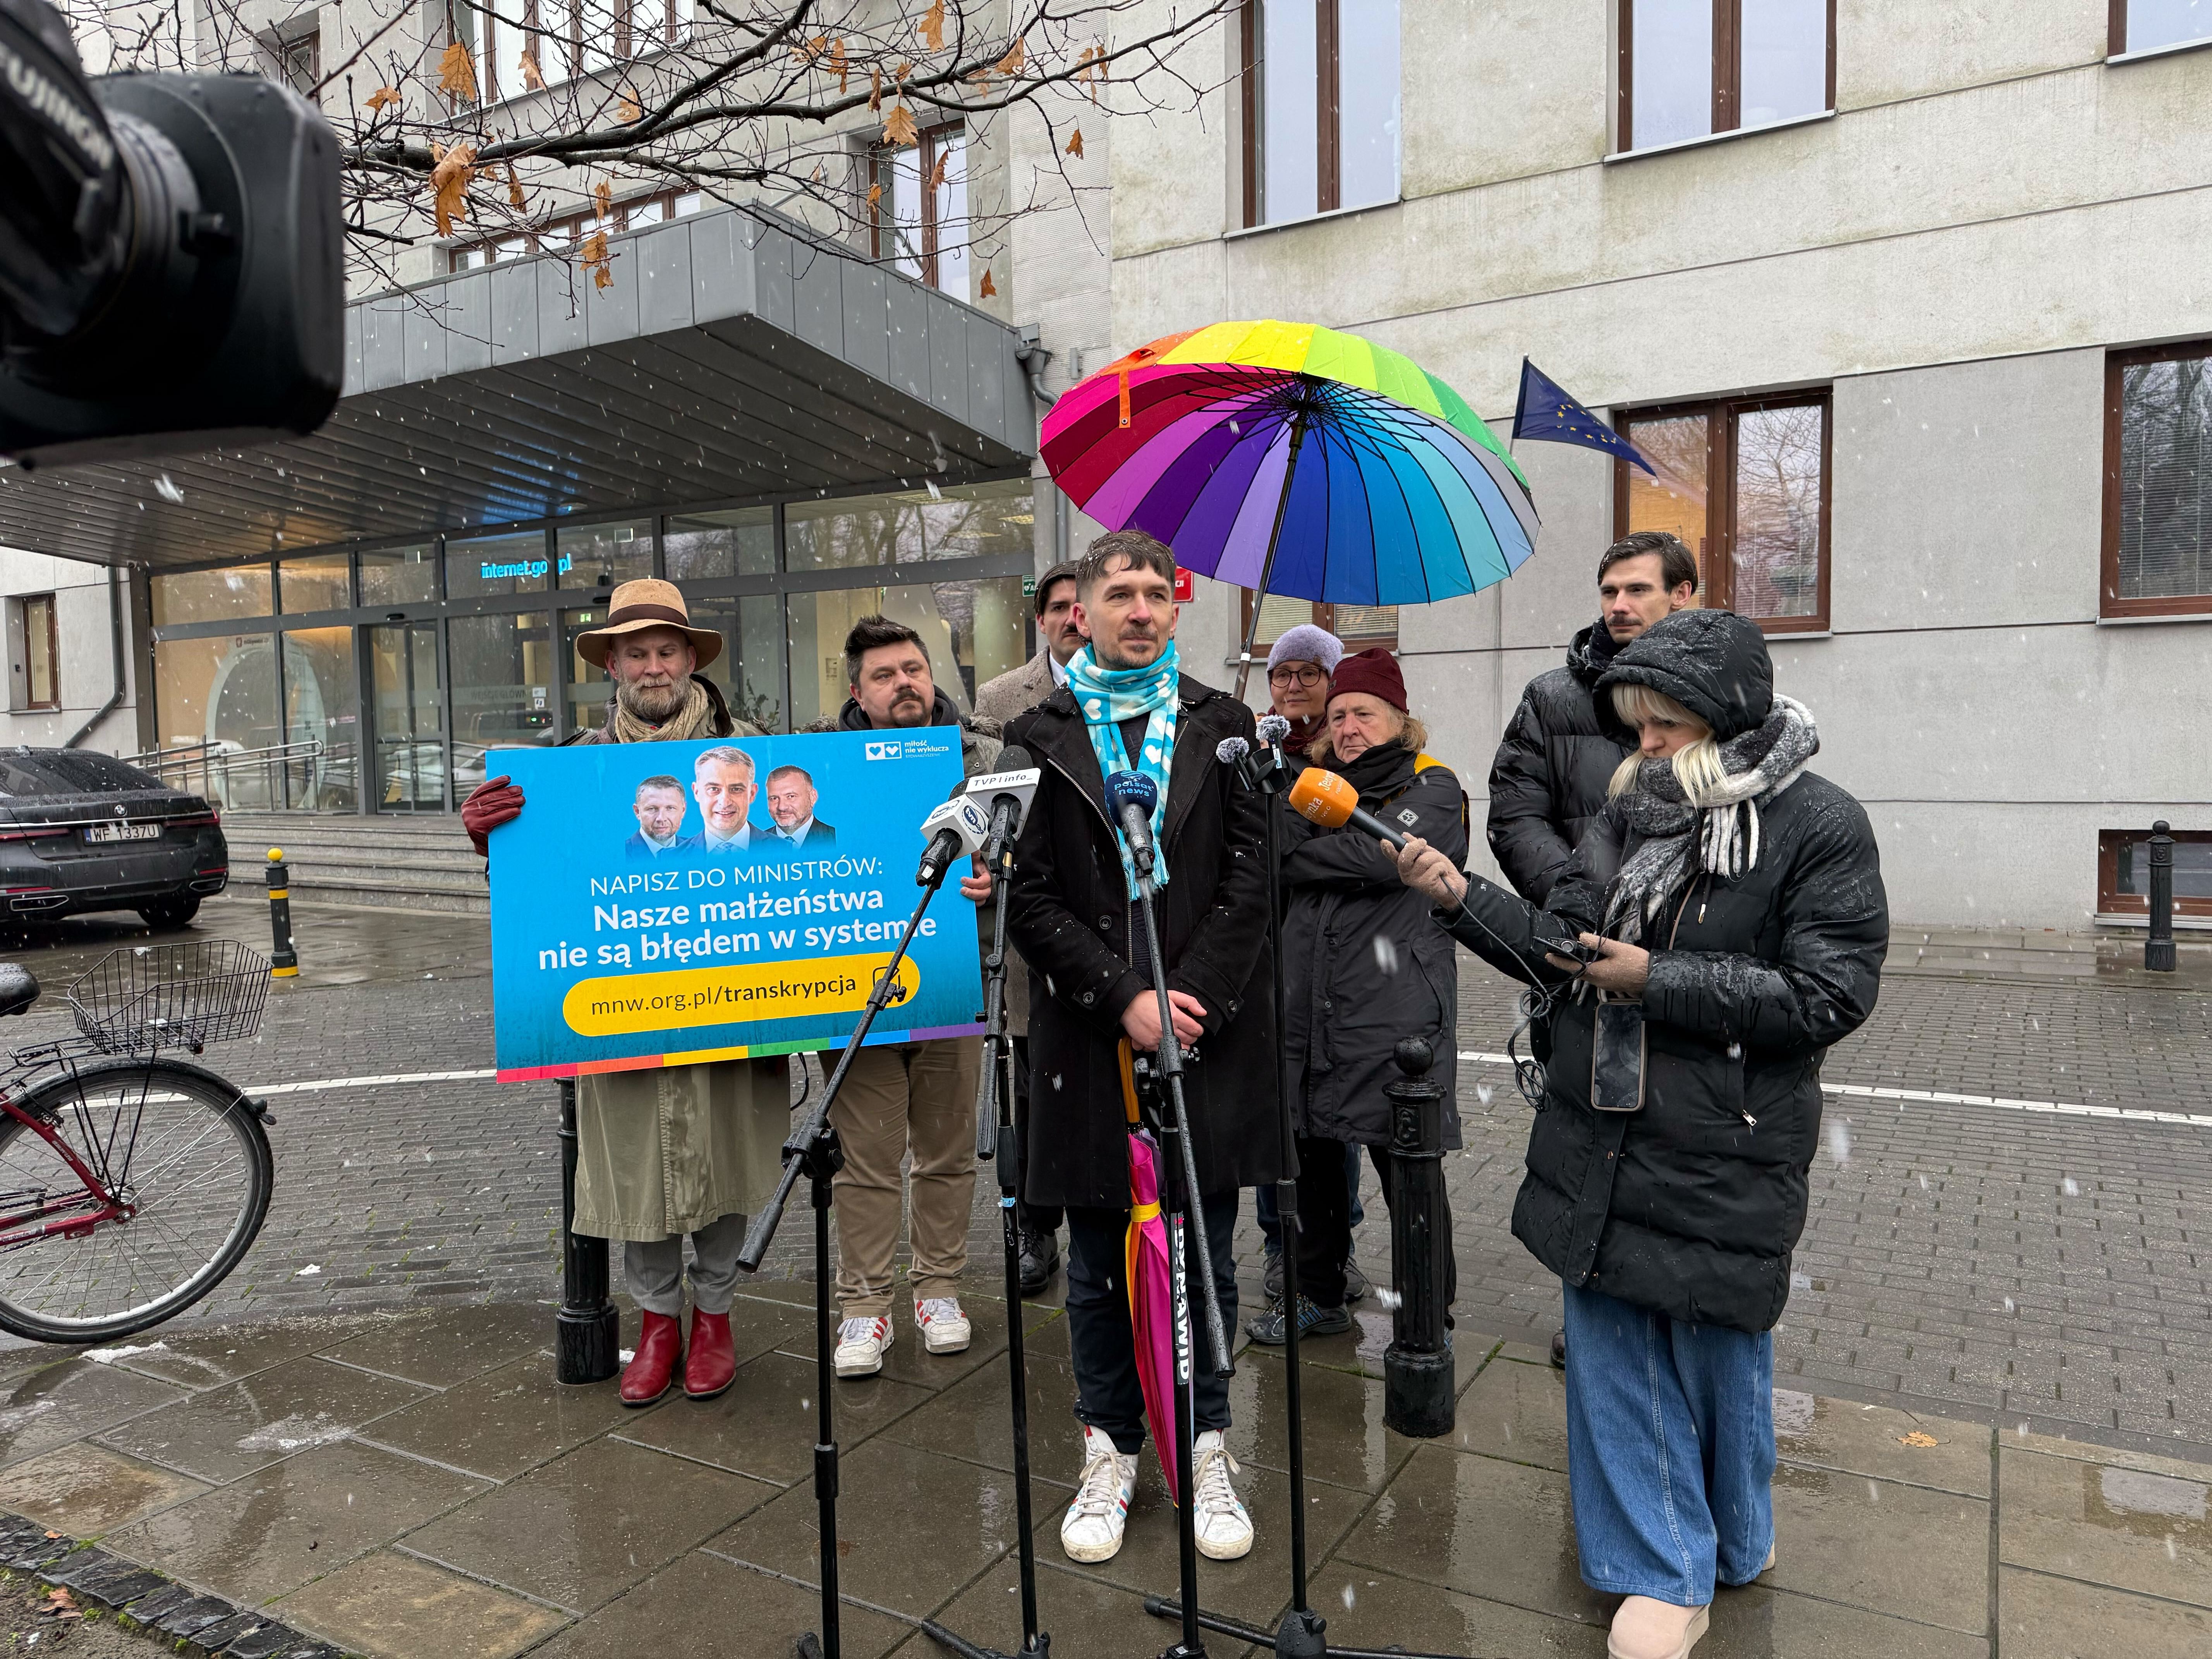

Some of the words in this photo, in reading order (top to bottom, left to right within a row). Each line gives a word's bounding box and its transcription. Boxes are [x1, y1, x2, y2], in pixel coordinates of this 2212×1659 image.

[974, 778, 996, 787] TVP
[1114, 780, 1153, 792] polsat
[1118, 788, 1150, 797] news
[93, 828, 110, 841] WF
[118, 825, 155, 840] 1337U
[591, 872, 680, 896] NAPISZ
[688, 869, 725, 888] DO
[735, 854, 883, 885] MINISTRÓW:
[594, 904, 689, 931] Nasze
[700, 889, 883, 924] małżeństwa
[539, 941, 587, 970] nie
[598, 944, 632, 968] są
[641, 929, 760, 963] błędem
[768, 929, 796, 949] w
[592, 976, 856, 1015] mnw.org.pl/transkrypcja
